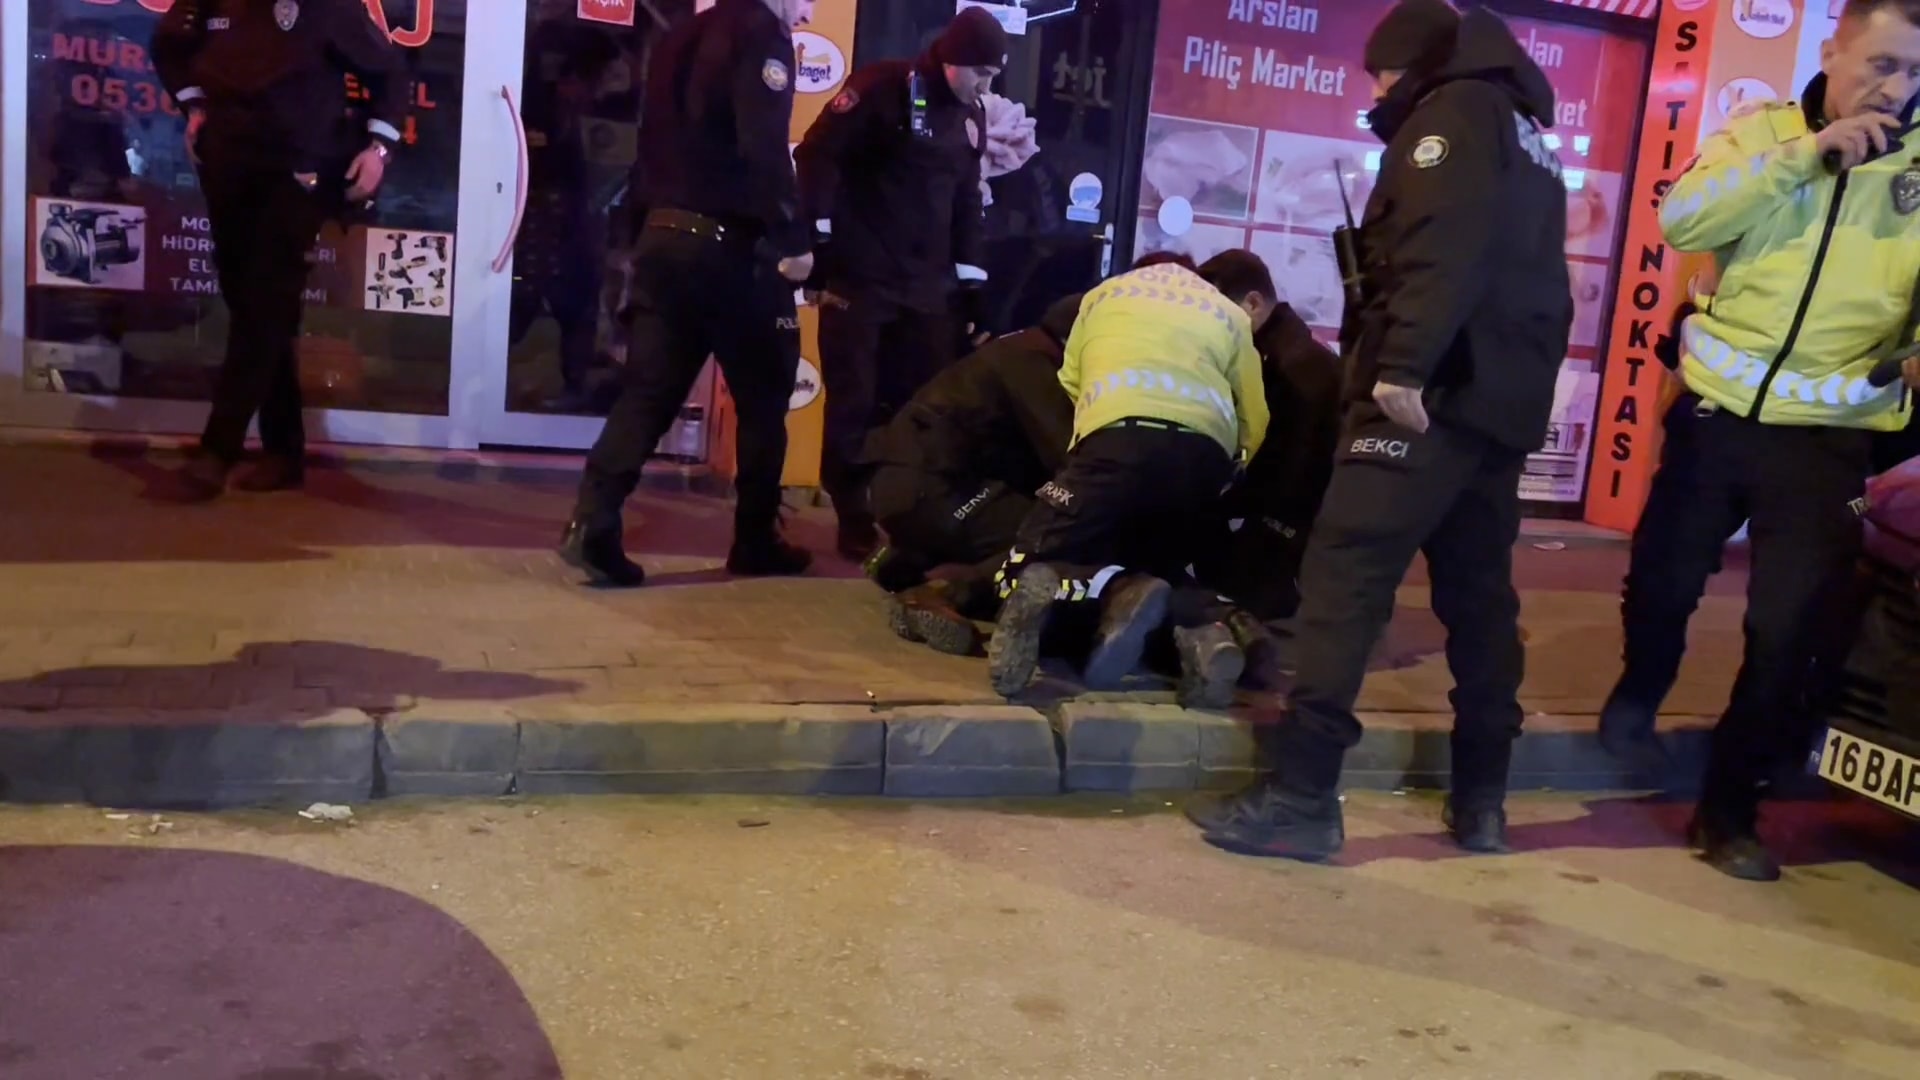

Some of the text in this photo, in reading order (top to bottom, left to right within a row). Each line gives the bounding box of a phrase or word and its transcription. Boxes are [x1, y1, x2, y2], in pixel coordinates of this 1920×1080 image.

[1227, 0, 1318, 33] Arslan
[53, 33, 155, 73] MUR
[1183, 36, 1346, 96] Piliç Market
[162, 235, 216, 252] HİDR
[1610, 243, 1665, 498] NOKTASI
[1828, 735, 1861, 783] 16
